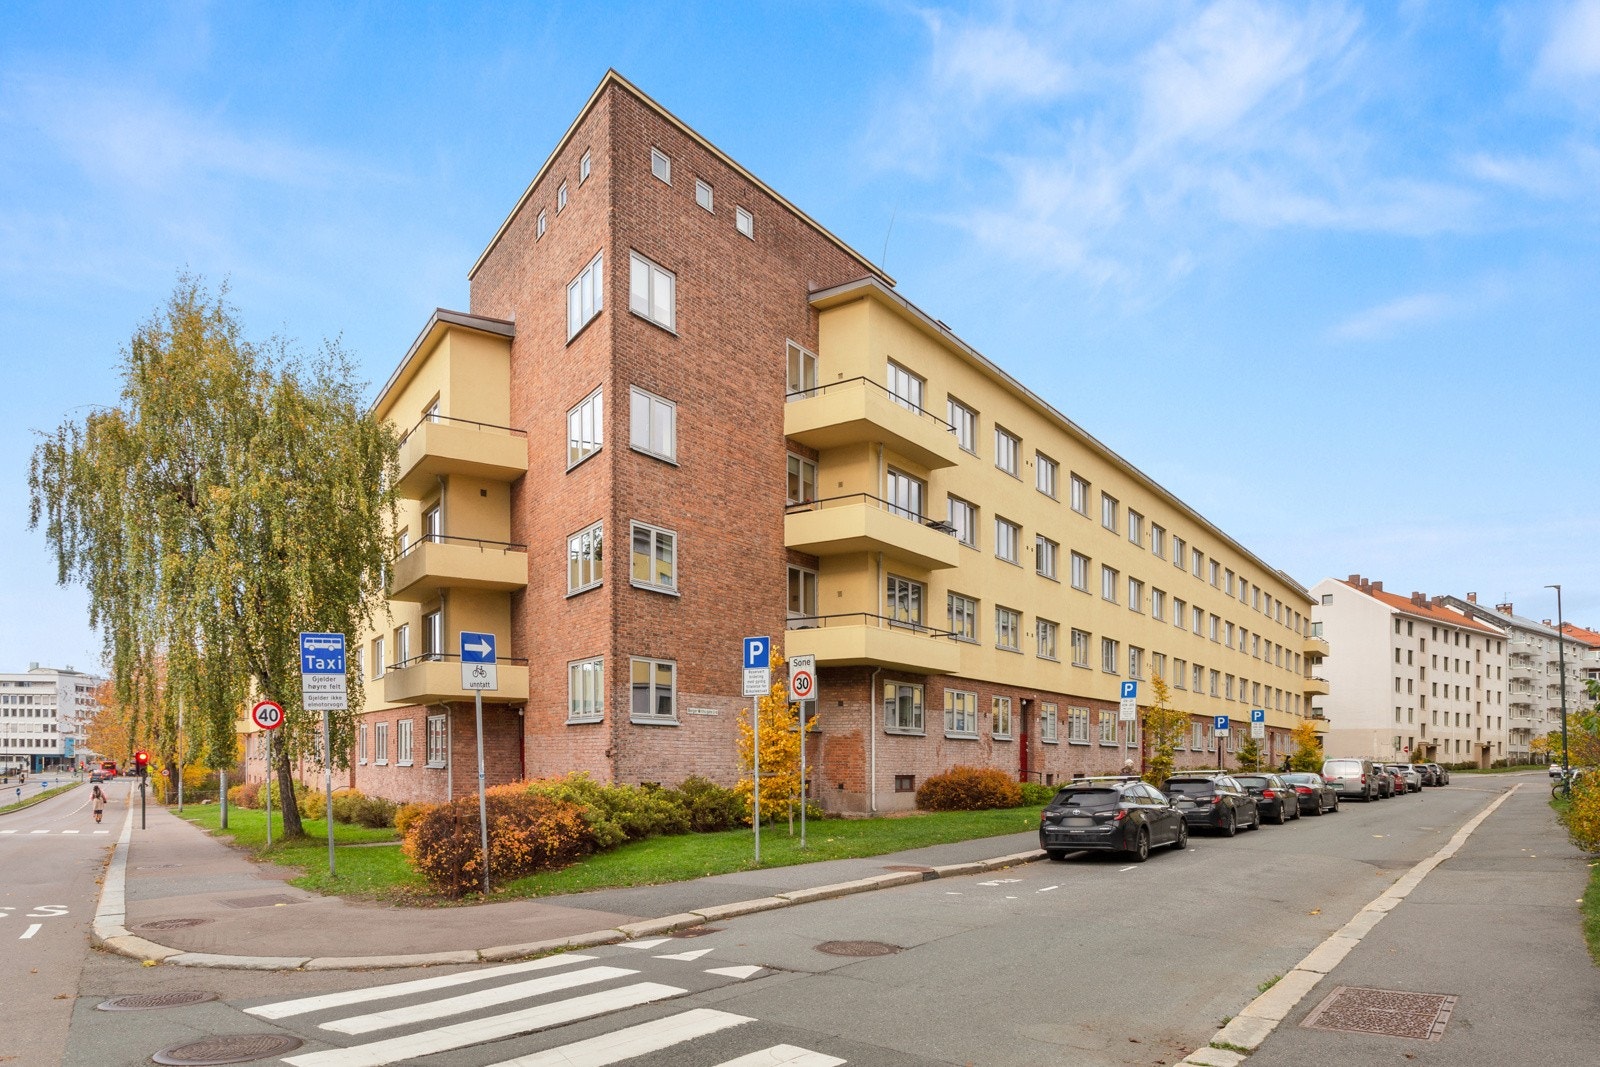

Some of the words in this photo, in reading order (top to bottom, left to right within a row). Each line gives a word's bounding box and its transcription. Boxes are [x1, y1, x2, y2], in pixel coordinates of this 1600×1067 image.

[750, 641, 764, 665] P
[305, 655, 342, 670] Taxi
[793, 659, 811, 667] Sone
[311, 675, 336, 683] Gjelder
[796, 677, 809, 690] 30
[1124, 683, 1134, 697] P
[258, 708, 279, 722] 40
[1254, 711, 1262, 721] P
[1217, 717, 1226, 728] P
